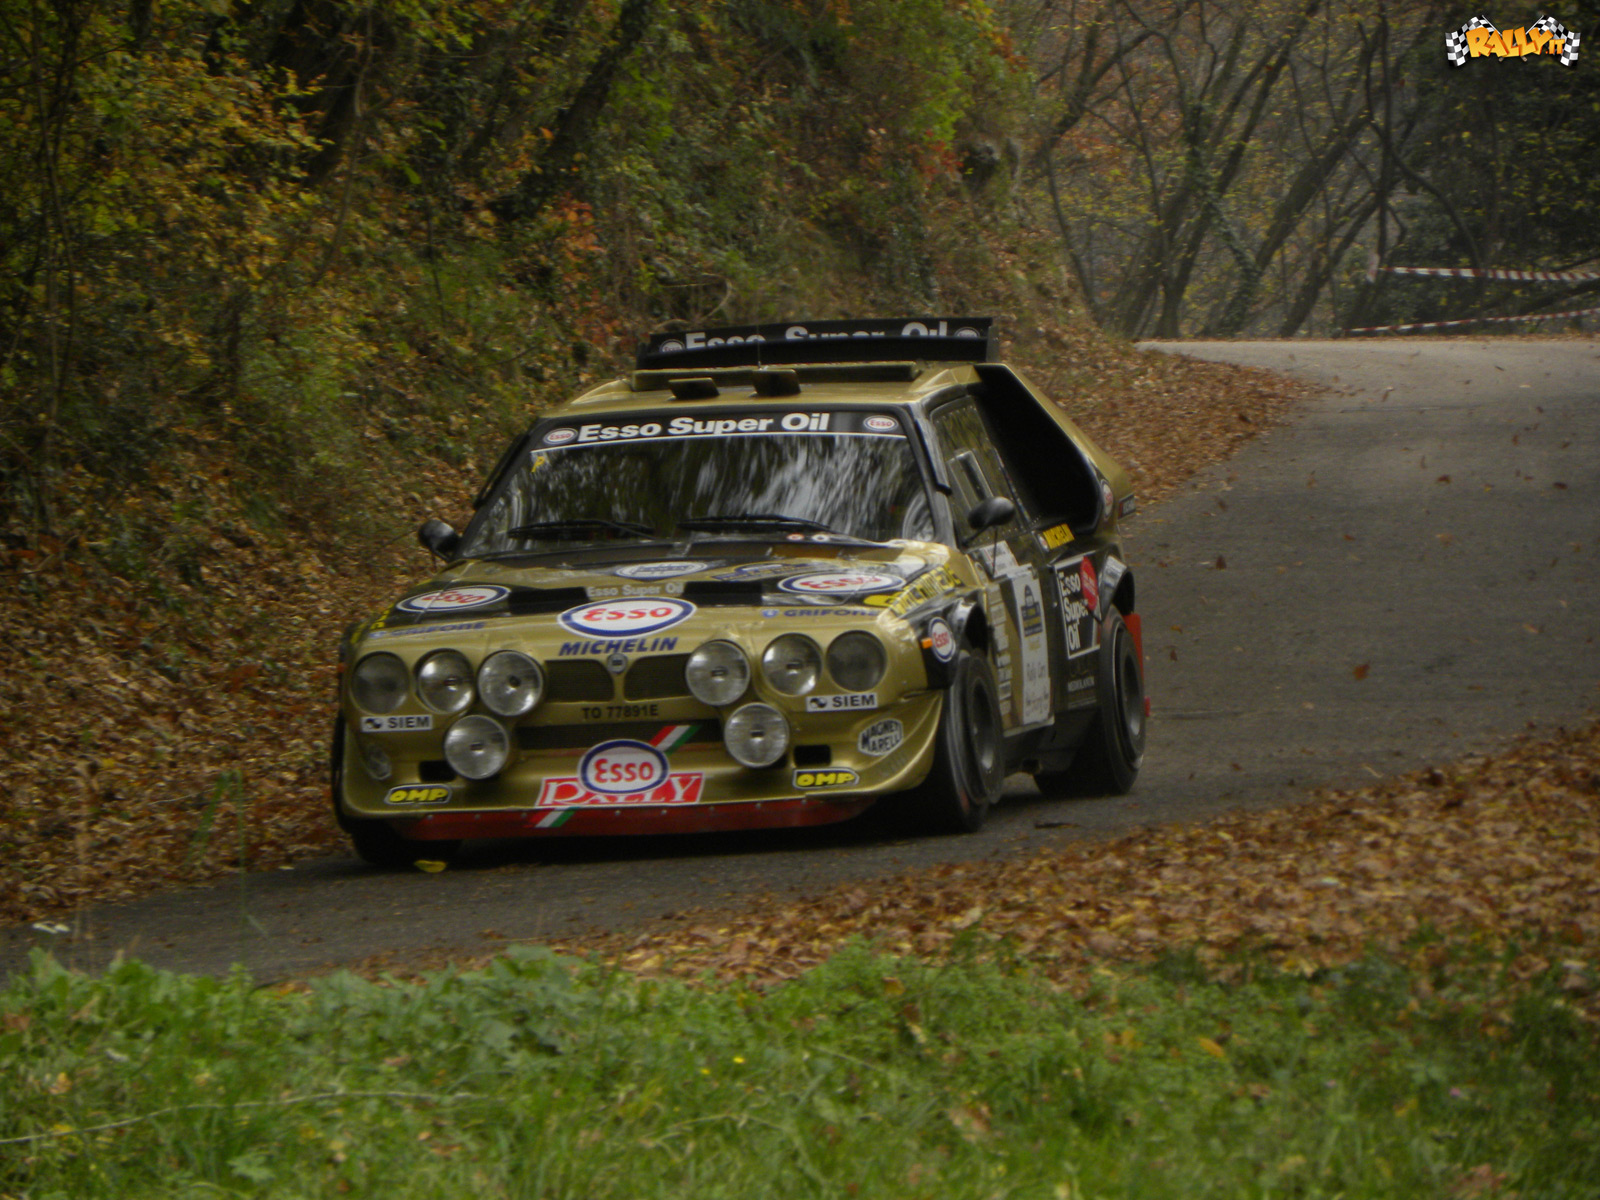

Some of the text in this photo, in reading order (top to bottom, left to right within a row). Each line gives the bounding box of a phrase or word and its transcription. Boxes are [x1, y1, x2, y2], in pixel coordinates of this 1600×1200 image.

[577, 412, 830, 442] Esso Super Oil
[586, 583, 685, 597] Esso Super Oil
[582, 607, 674, 622] Esso
[558, 637, 679, 657] MICHELIN
[832, 694, 876, 708] SIEM
[388, 716, 430, 729] SIEM
[594, 758, 655, 784] Esso
[796, 772, 855, 787] OMP
[389, 788, 449, 802] OMP
